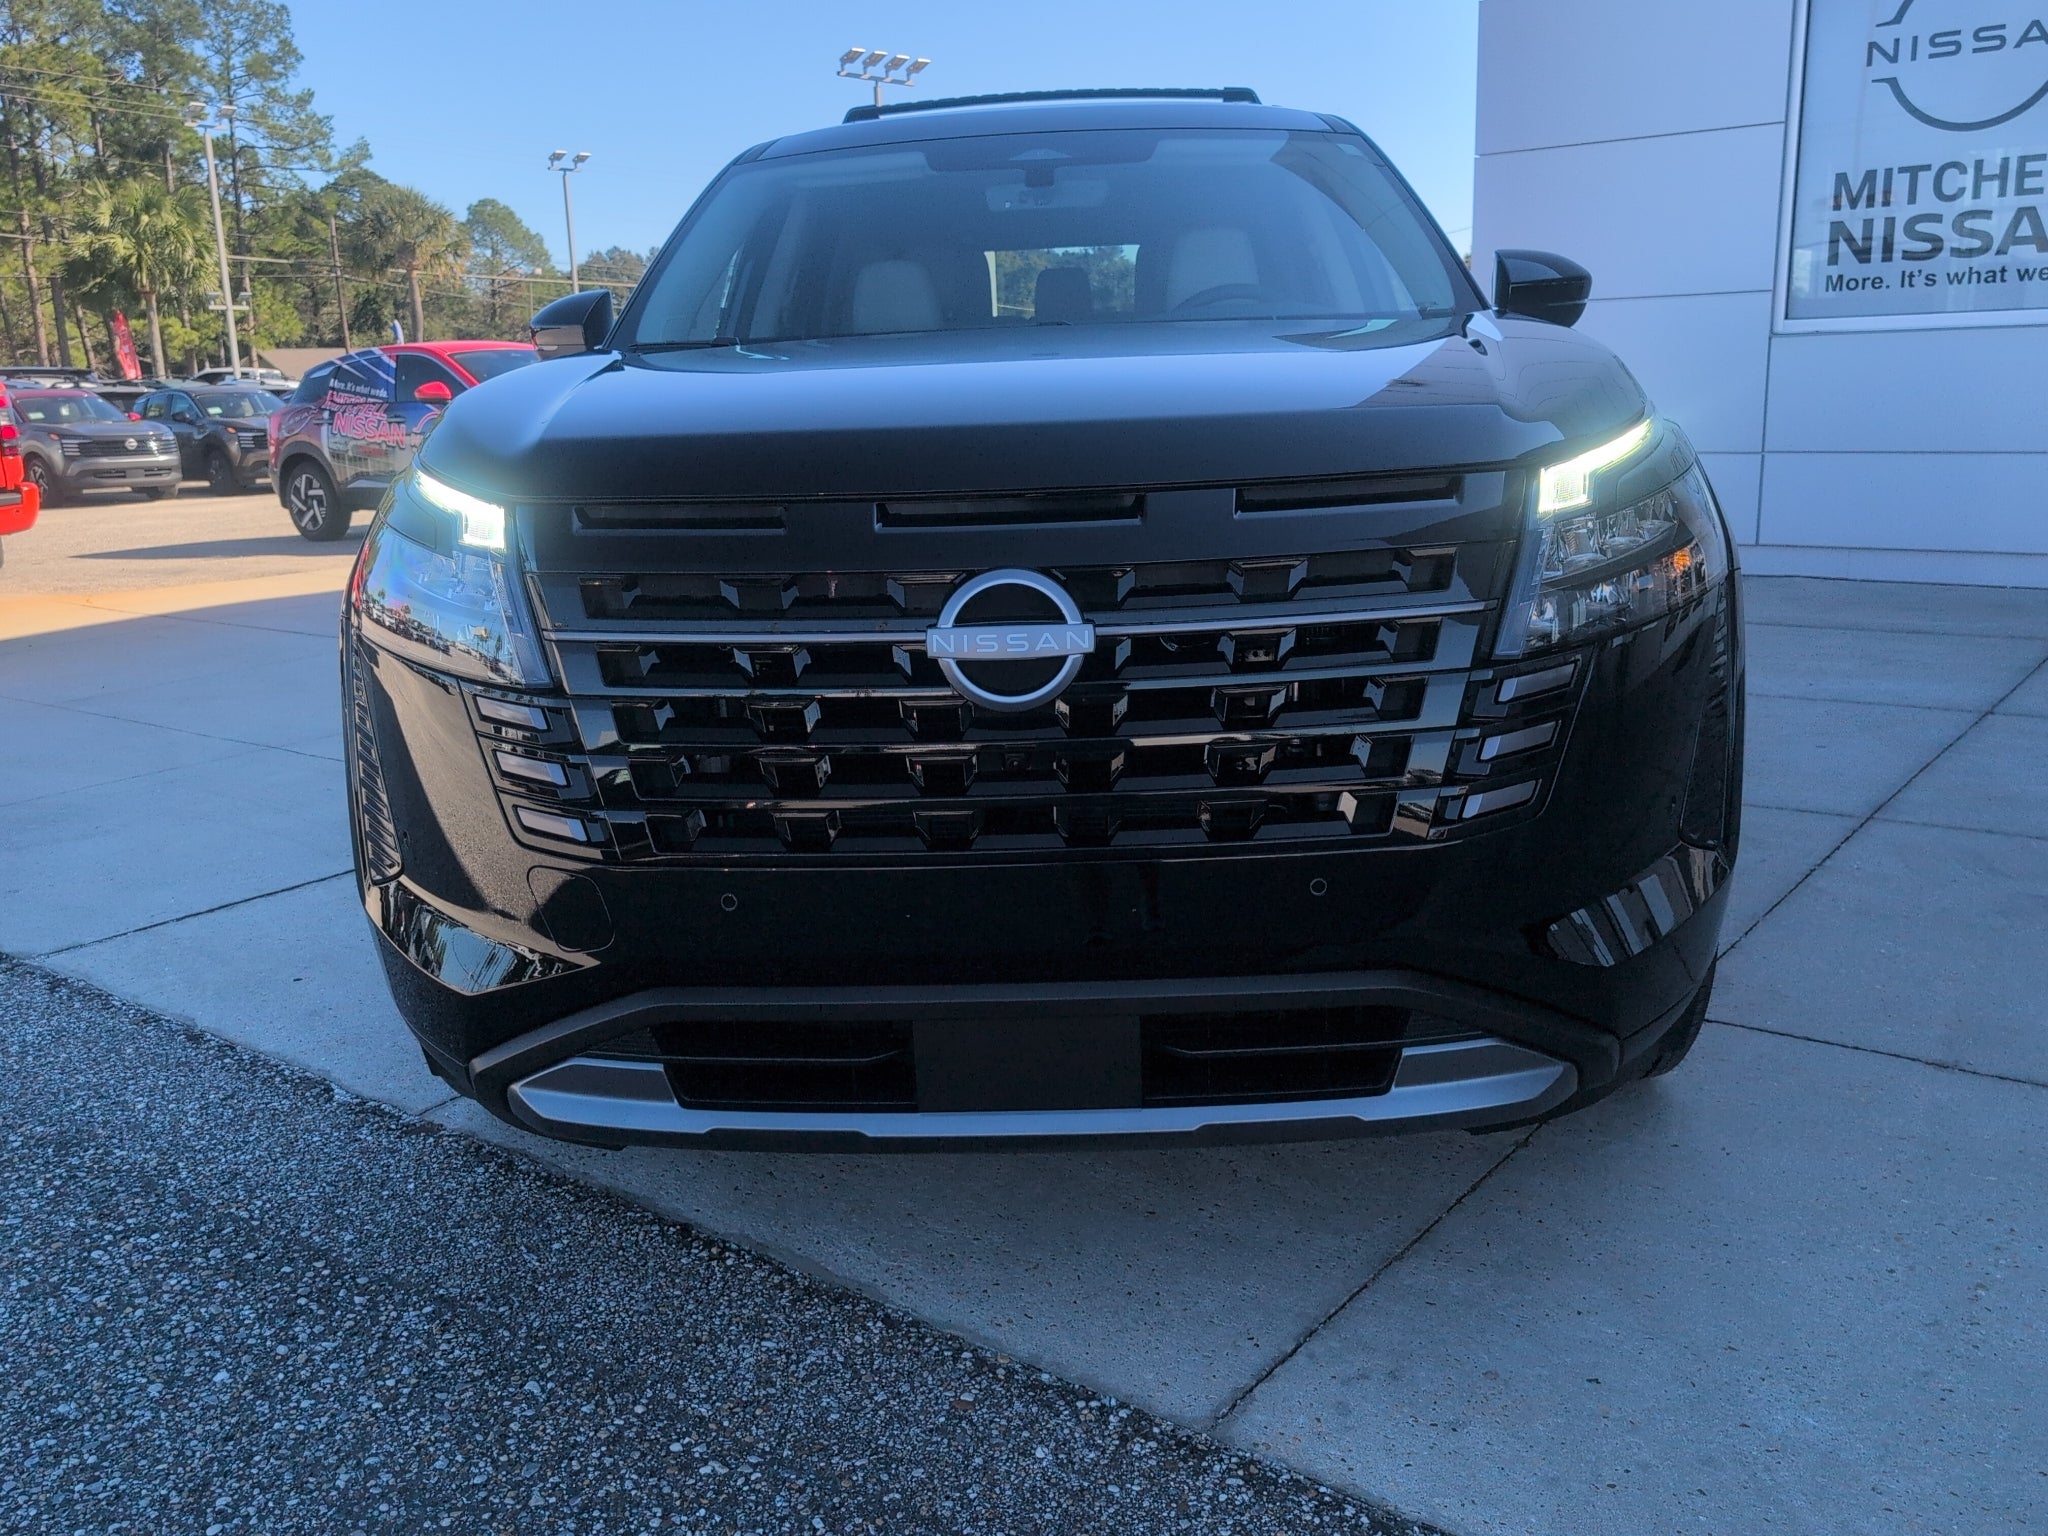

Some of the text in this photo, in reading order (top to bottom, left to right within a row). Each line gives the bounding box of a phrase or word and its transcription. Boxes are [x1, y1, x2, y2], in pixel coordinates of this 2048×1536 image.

[1832, 153, 2047, 212] MITCHE
[1825, 274, 1890, 293] More.
[1946, 265, 2008, 285] what
[2016, 266, 2048, 282] we
[332, 411, 406, 449] NISSAN
[932, 630, 1089, 653] NISSAN
